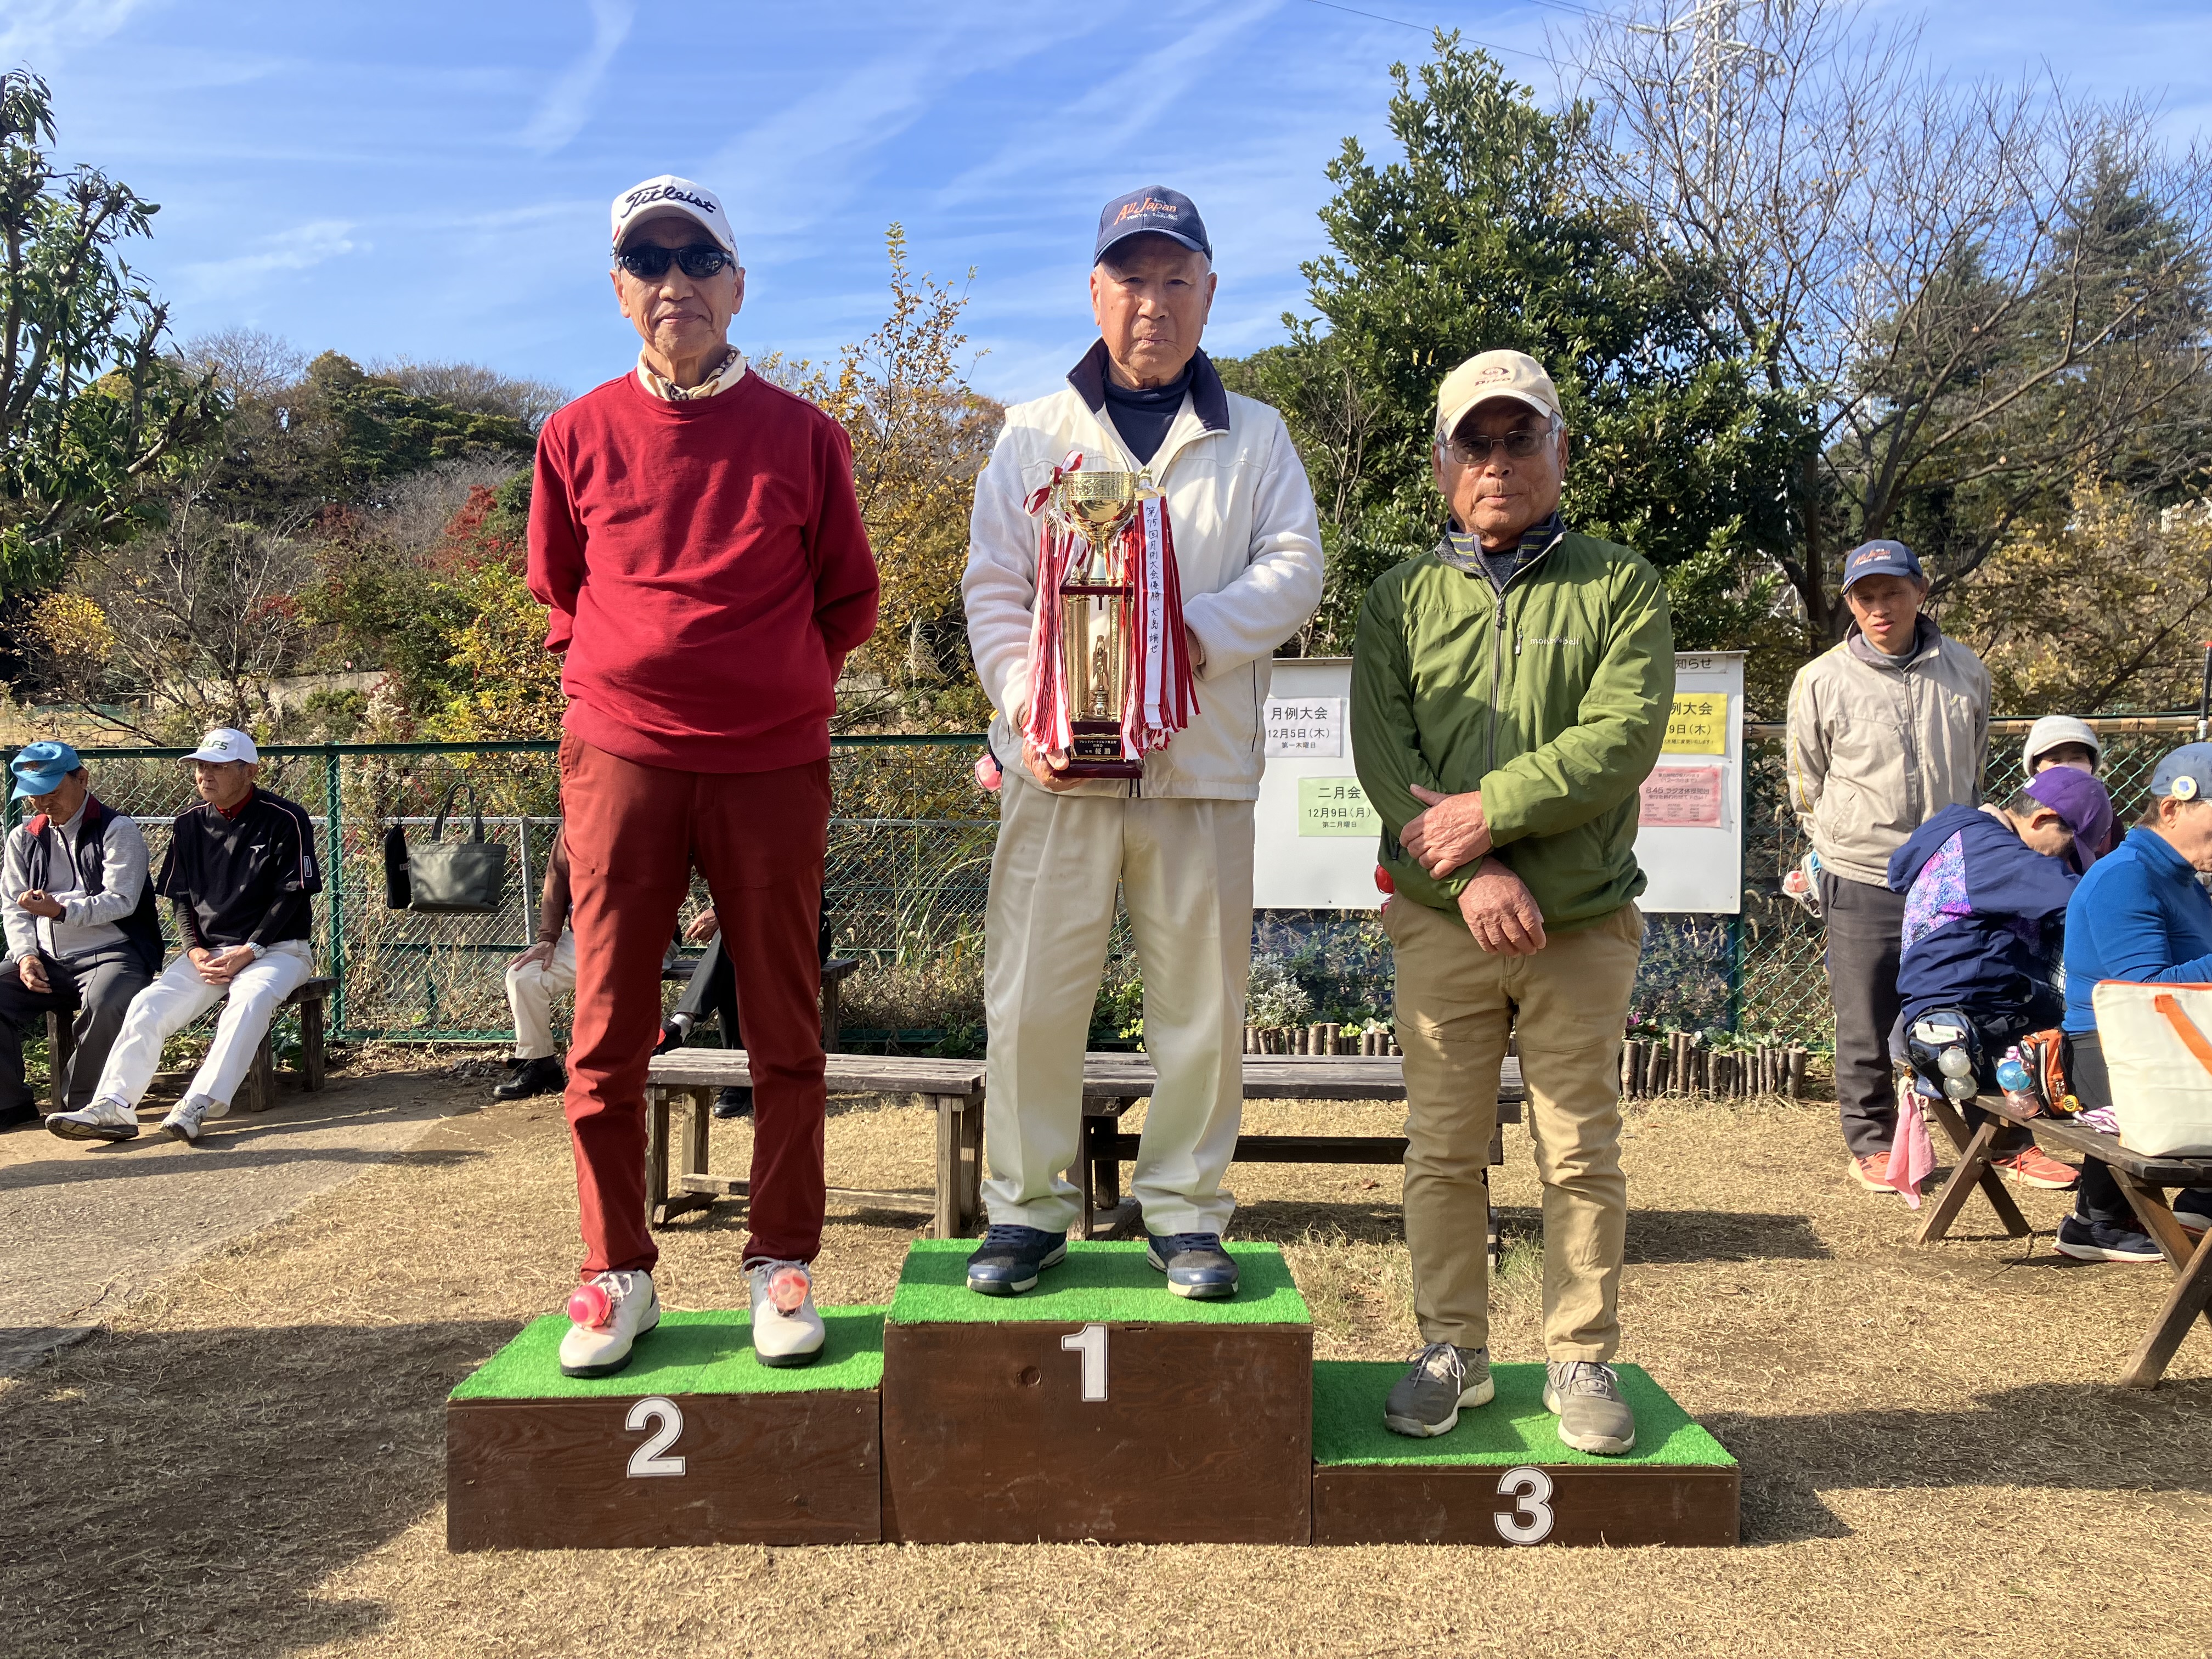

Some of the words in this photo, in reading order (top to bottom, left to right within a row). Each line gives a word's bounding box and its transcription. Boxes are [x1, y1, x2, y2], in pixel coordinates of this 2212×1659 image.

[620, 184, 716, 218] Titleist
[1271, 706, 1328, 720] 月例大会
[1267, 728, 1330, 739] 12月5日(木)
[200, 740, 229, 751] OLF5
[1318, 786, 1361, 799] 二月会
[1308, 807, 1371, 818] 12月9日(月)
[1061, 1323, 1109, 1402] 1
[625, 1396, 685, 1478] 2
[1494, 1466, 1554, 1544] 3
